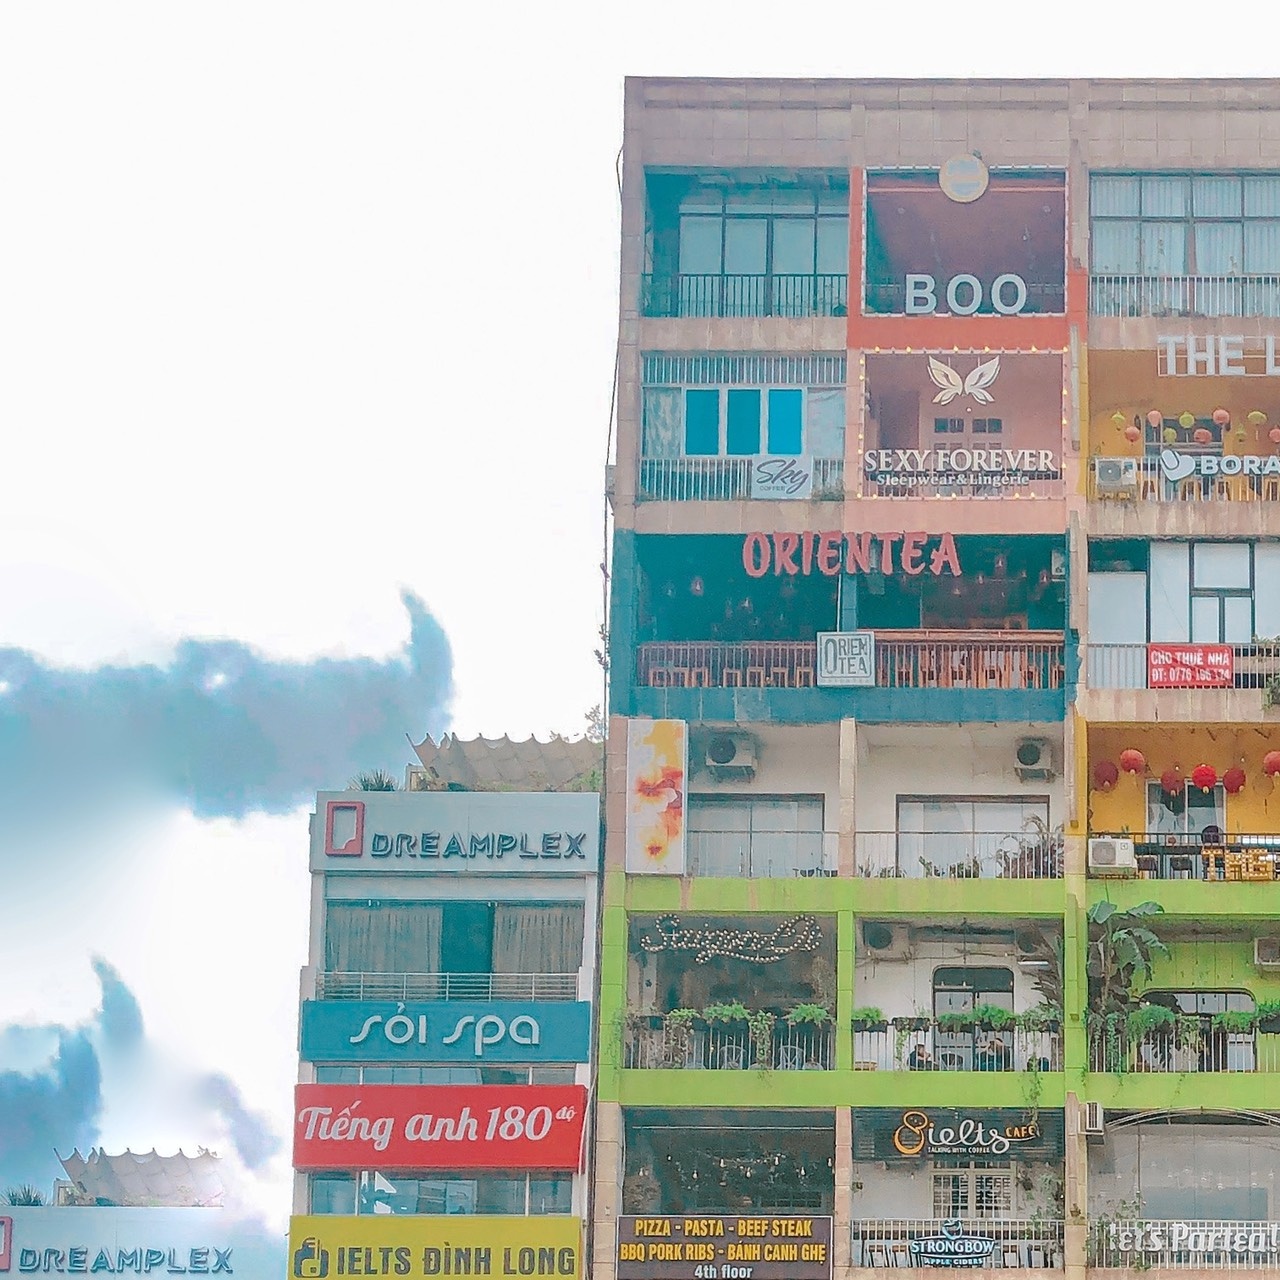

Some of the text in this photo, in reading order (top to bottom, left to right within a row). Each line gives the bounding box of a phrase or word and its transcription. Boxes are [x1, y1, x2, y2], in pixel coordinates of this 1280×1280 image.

[904, 273, 1028, 315] BOO
[1158, 335, 1246, 376] THE
[864, 449, 1056, 472] SEXY FOREVER
[756, 459, 810, 493] Sky
[743, 530, 962, 577] ORIENTEA
[1151, 651, 1172, 665] CHO
[371, 833, 586, 859] DREAMPLEX
[1202, 848, 1273, 881] THE
[350, 1002, 540, 1056] sỏi spa
[299, 1101, 393, 1151] Tiếng
[404, 1107, 478, 1141] anh
[485, 1105, 552, 1142] 180
[1005, 1125, 1035, 1138] CAFE
[635, 1219, 812, 1237] PIZZA PASTA BEEF STEAK
[18, 1246, 234, 1274] DREAMPLEX
[337, 1241, 575, 1276] IELTS ĐÌNH LONG
[620, 1240, 826, 1264] BBQ PORK RIBS BÁNH CANH GHẸ
[911, 1240, 995, 1253] STRONGBOW
[694, 1264, 753, 1279] 4th floor
